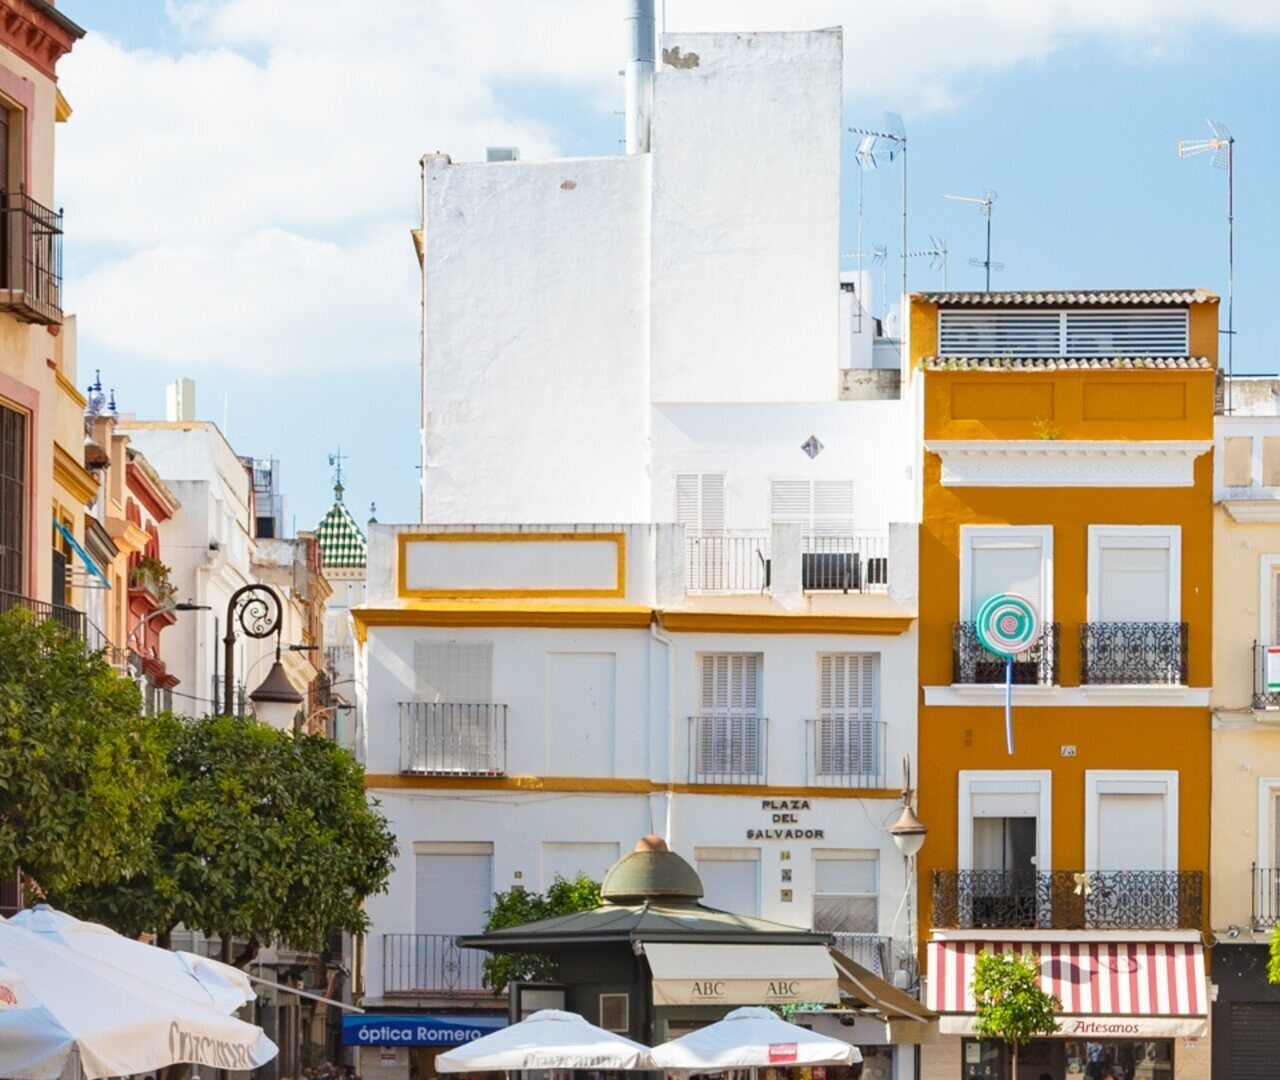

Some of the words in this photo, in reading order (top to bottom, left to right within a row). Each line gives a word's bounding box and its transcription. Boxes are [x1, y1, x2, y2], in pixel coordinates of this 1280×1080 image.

[762, 800, 810, 810] PLAZA
[772, 814, 798, 823] DEL
[746, 829, 824, 839] SALVADOR
[691, 982, 726, 996] ABC
[766, 982, 800, 996] ABC
[1073, 1020, 1140, 1033] Artesanos
[359, 1025, 412, 1043] óptica
[417, 1027, 481, 1041] Romero
